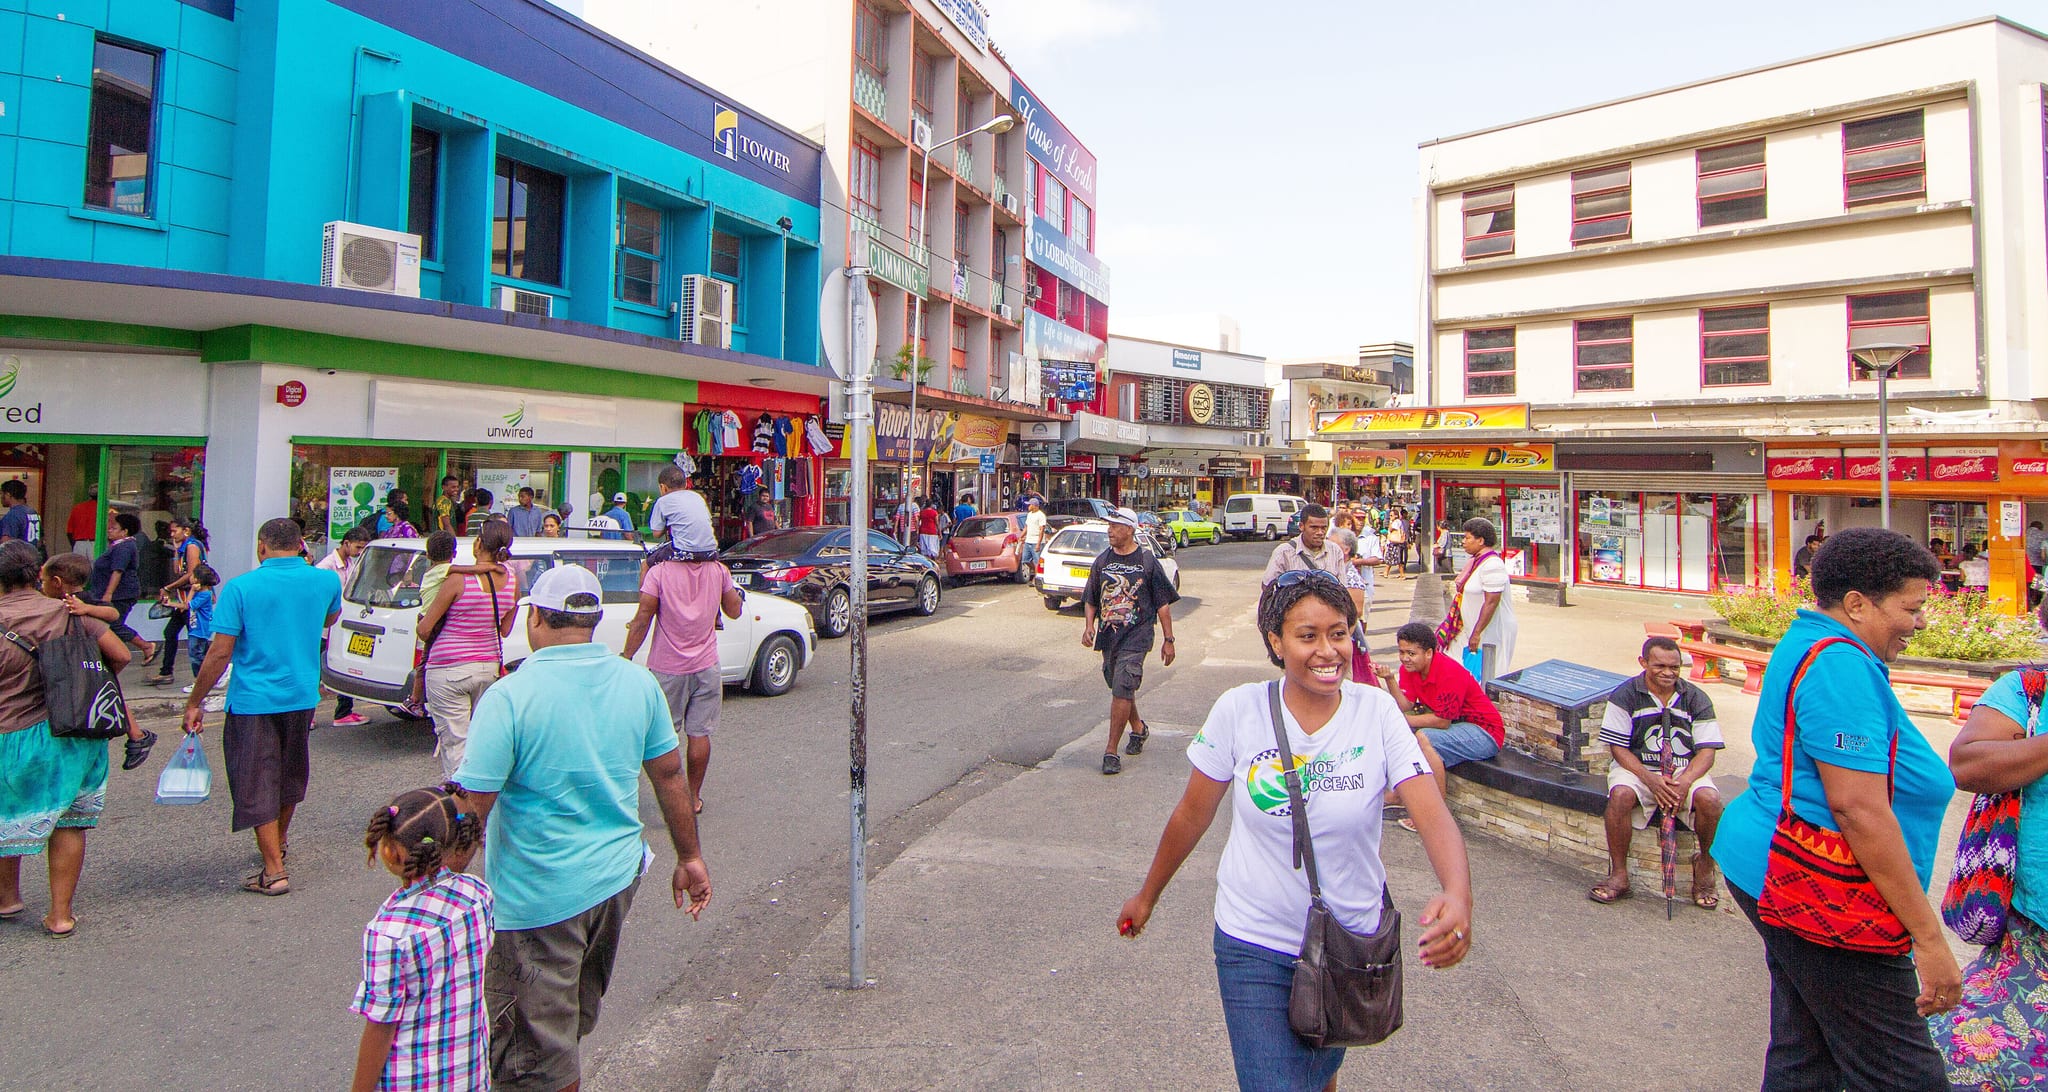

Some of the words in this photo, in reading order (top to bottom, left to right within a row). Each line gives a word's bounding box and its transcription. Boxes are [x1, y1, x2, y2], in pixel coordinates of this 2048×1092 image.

[1018, 95, 1053, 156] House
[1053, 144, 1067, 172] of
[1065, 148, 1092, 194] Lords
[740, 135, 790, 174] TOWER
[1044, 239, 1071, 271] LORDS
[870, 243, 918, 291] CUMMING
[920, 271, 926, 285] ST
[877, 408, 929, 440] ROOPSH
[1371, 411, 1417, 424] PHONE
[487, 427, 533, 438] unwired
[1433, 450, 1472, 459] PHONE
[348, 470, 386, 478] REWARDED
[588, 519, 608, 528] TAXI
[1308, 773, 1364, 792] OCEAN
